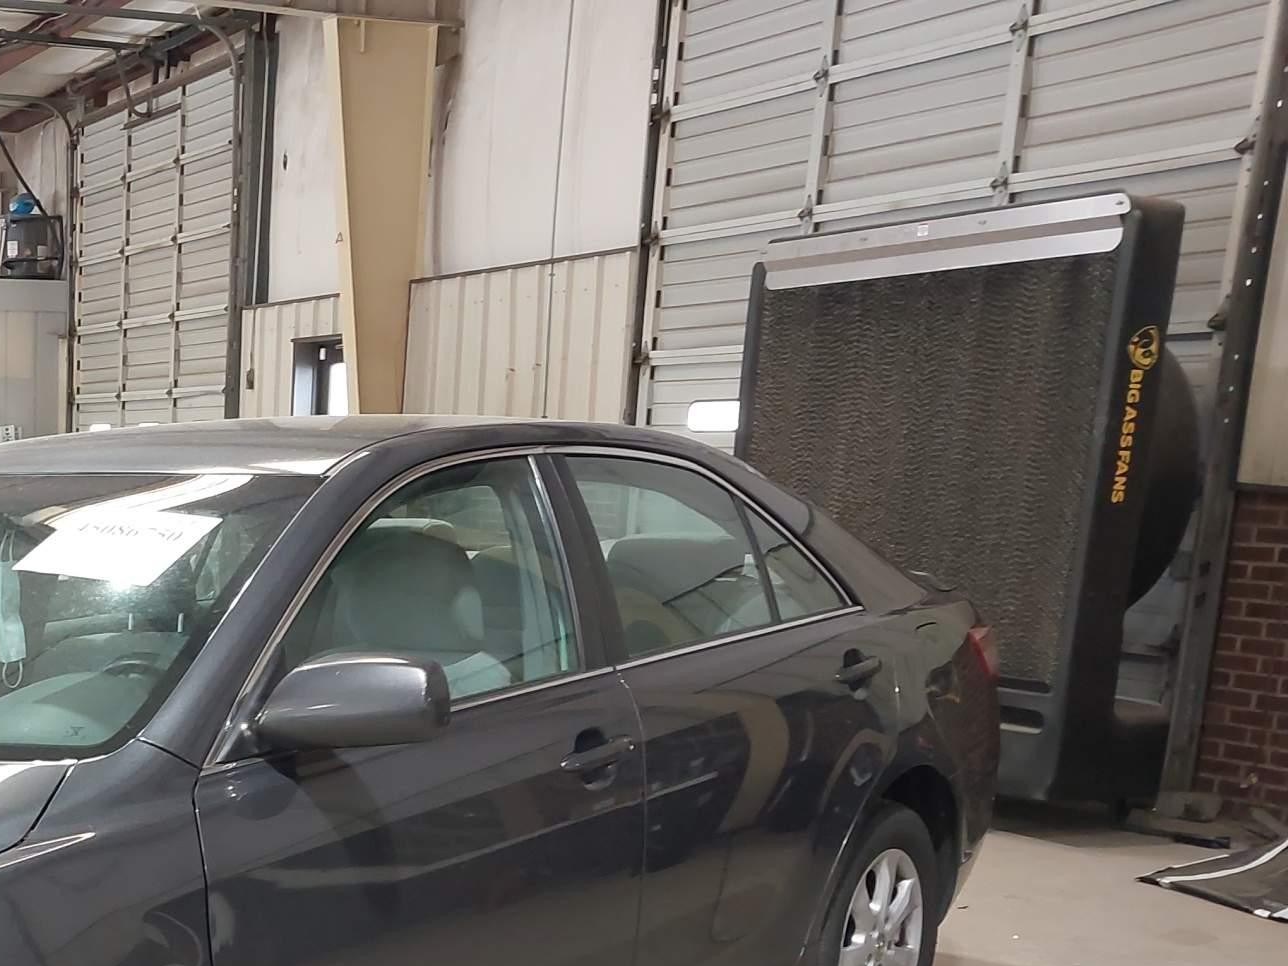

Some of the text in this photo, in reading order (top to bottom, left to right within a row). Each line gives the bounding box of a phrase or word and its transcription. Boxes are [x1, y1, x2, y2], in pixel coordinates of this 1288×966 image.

[1111, 369, 1145, 503] BIG ASS FANS
